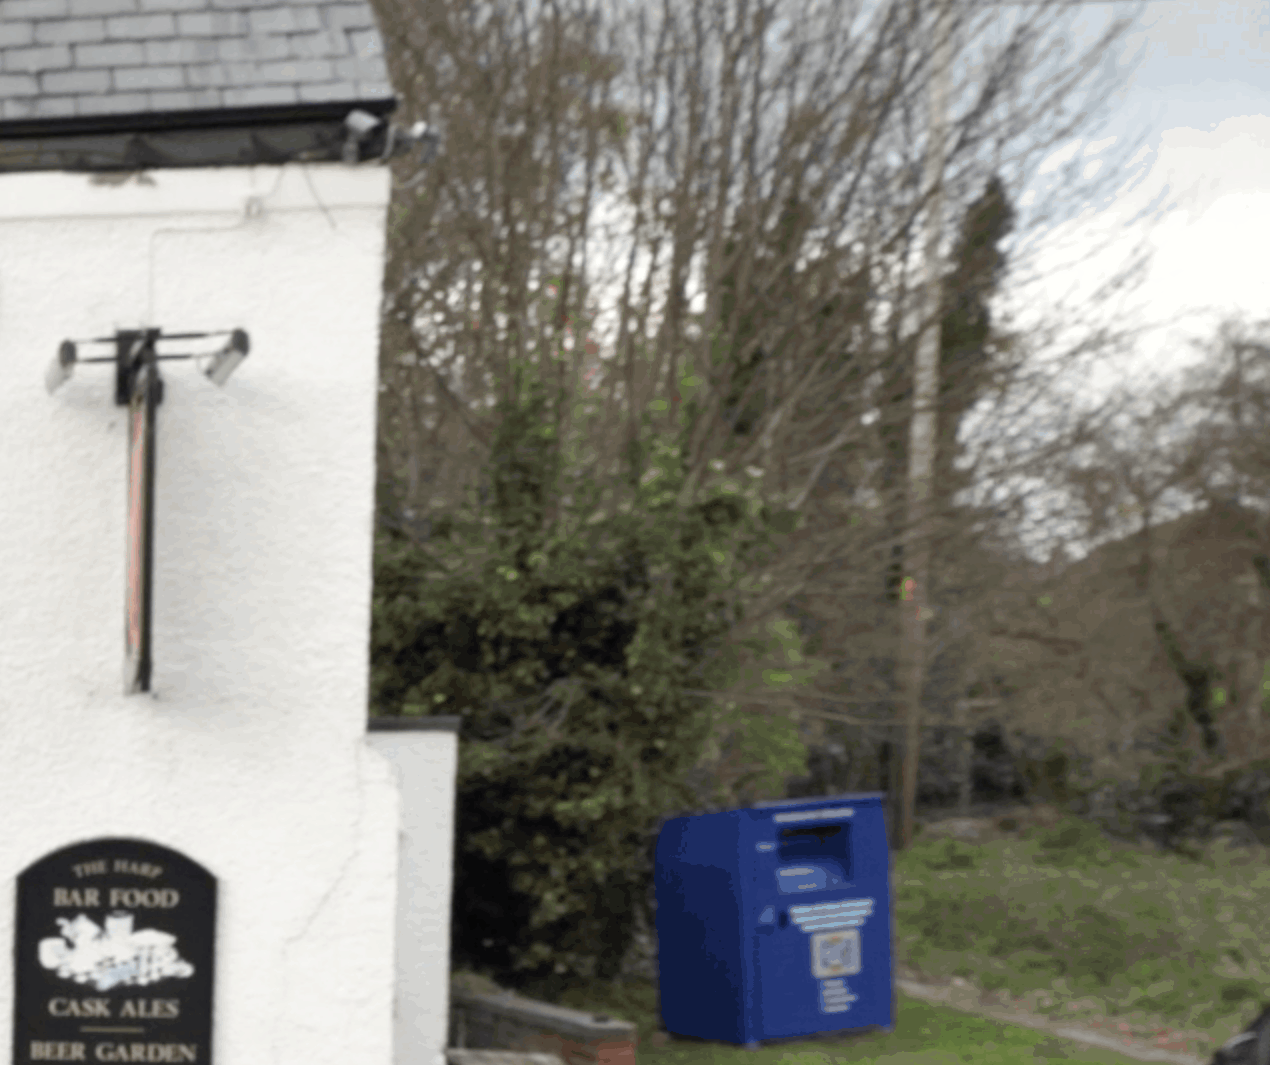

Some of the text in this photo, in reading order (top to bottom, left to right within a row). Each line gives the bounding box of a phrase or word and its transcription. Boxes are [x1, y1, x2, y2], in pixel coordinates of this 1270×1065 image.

[73, 860, 107, 878] THE
[53, 887, 180, 908] BAR FOOD
[48, 998, 180, 1019] CASK ALES
[30, 1041, 197, 1063] BEER GARDEN
